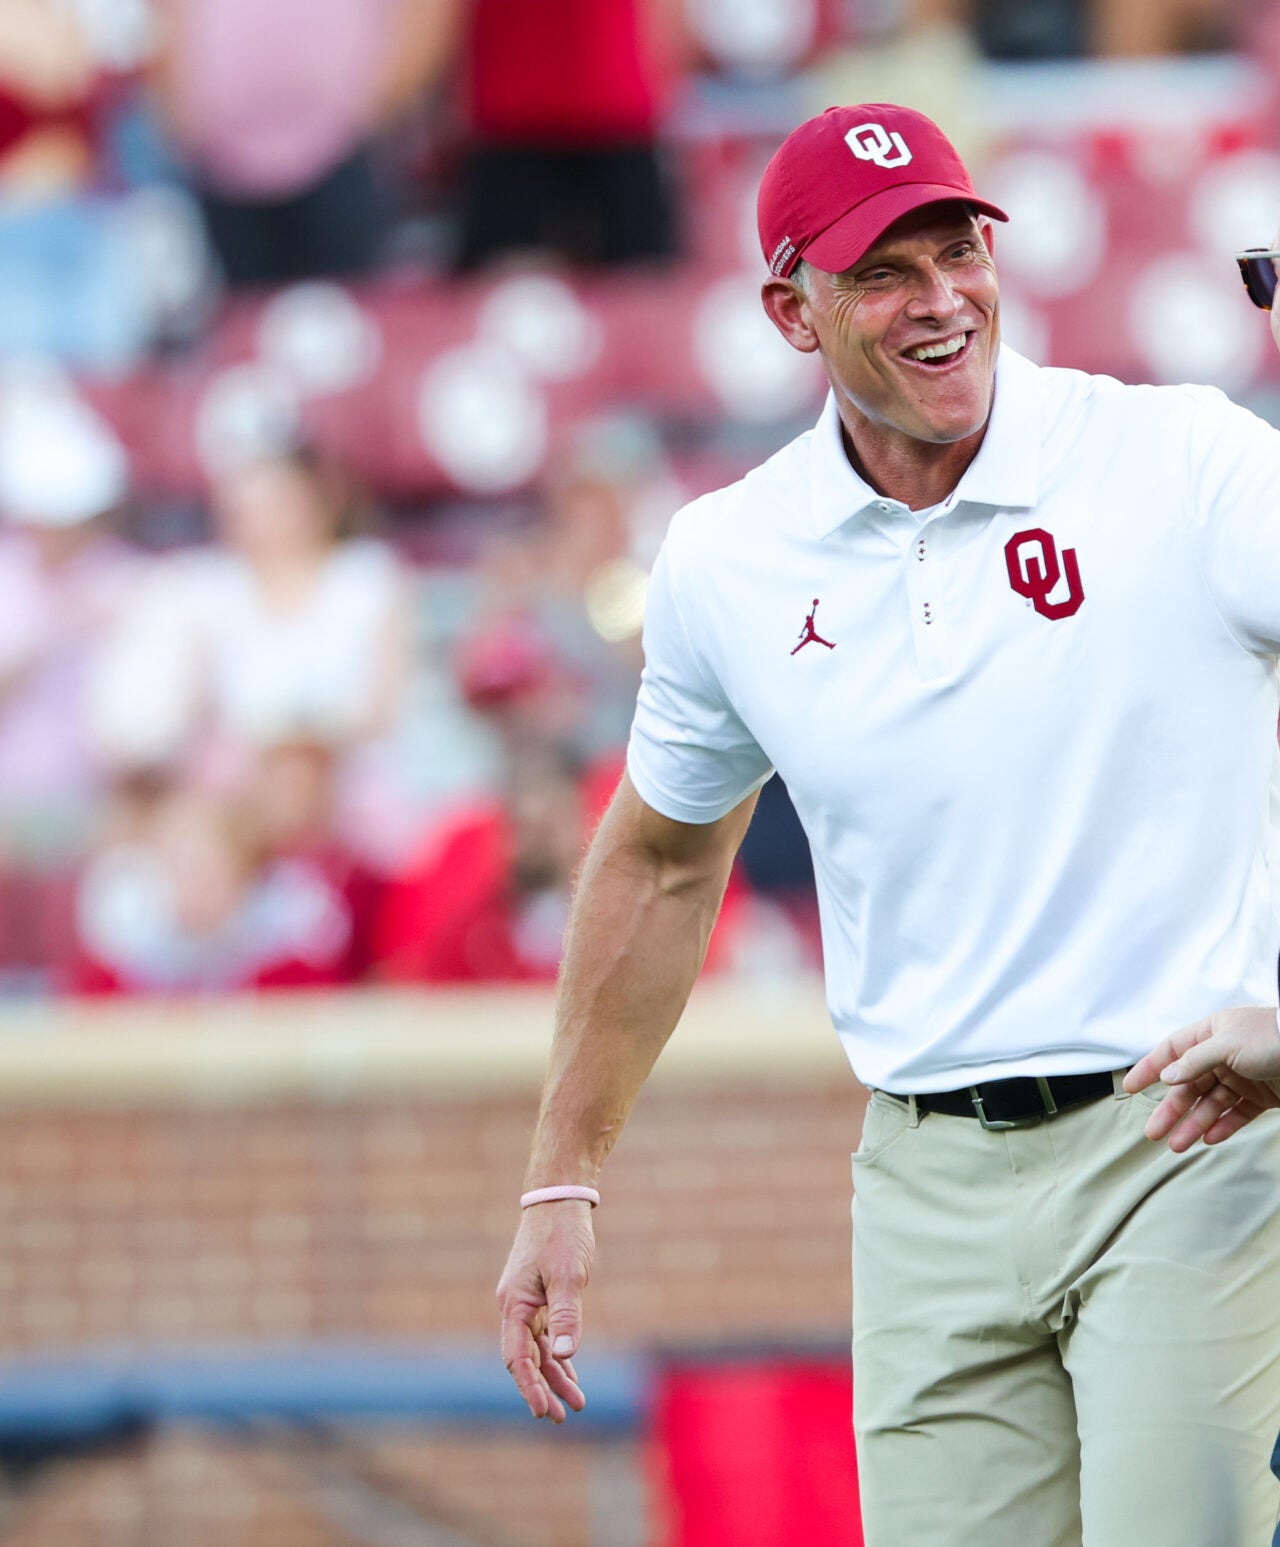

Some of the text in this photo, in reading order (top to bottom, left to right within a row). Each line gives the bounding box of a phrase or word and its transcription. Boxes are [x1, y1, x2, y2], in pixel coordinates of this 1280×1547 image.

[844, 123, 913, 169] OU
[770, 235, 791, 273] LAHOMA
[1004, 527, 1085, 621] OU
